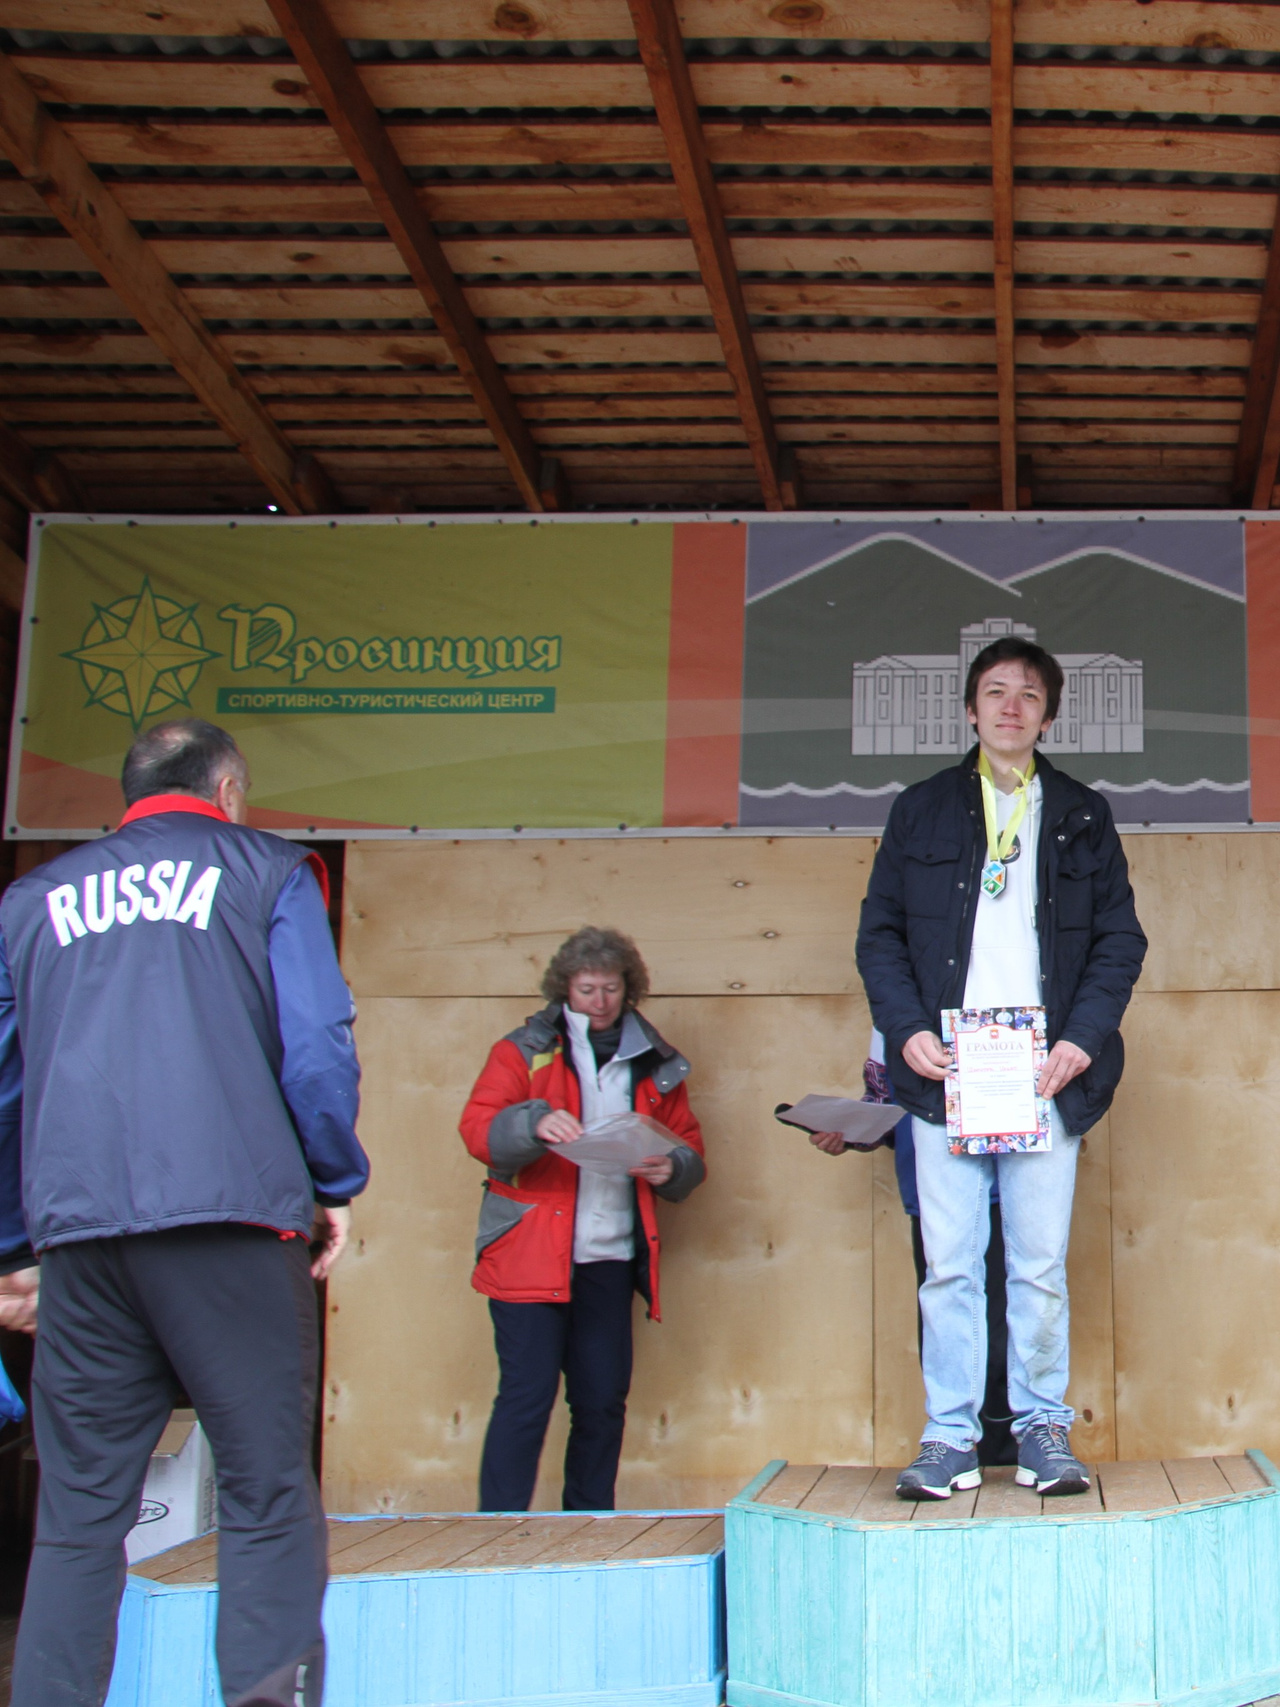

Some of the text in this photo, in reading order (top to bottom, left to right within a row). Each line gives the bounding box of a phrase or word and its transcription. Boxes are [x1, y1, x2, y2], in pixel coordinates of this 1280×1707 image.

[217, 602, 562, 685] Провинция
[227, 691, 546, 710] СПОРТИВНО-ТУРИСТИЧЕСКИЙ ЦЕНТР
[46, 859, 223, 947] RUSSIA
[966, 1041, 1024, 1051] ГРАМОТА
